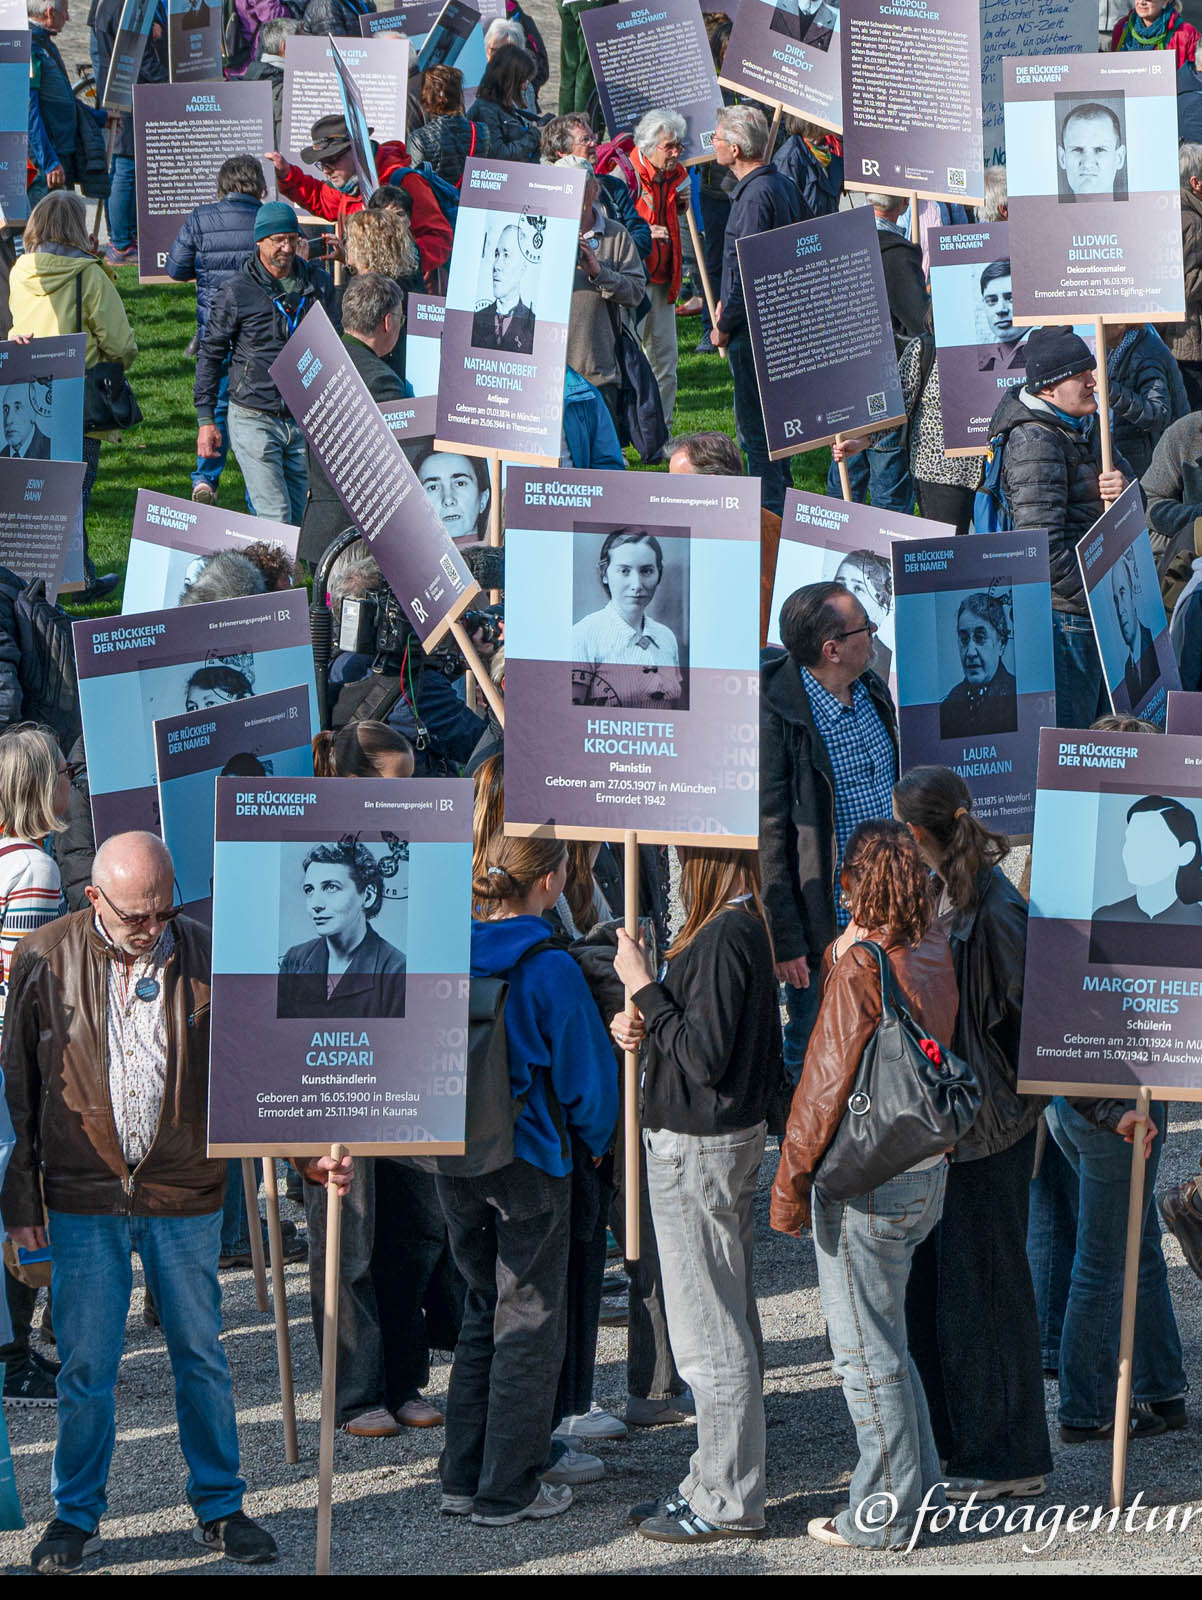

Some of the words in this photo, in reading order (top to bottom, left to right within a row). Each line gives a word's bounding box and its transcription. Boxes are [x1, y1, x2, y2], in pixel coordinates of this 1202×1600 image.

[879, 5, 939, 20] SCHWABACHER
[785, 43, 806, 59] DIRK
[772, 49, 814, 72] KOEDOOT
[1015, 66, 1028, 75] DIE
[1029, 64, 1069, 75] RÜCKKEHR
[1016, 74, 1031, 83] DER
[1031, 73, 1061, 83] NAMEN
[190, 95, 215, 103] ADELE
[185, 103, 221, 112] MARZELL
[796, 233, 820, 247] JOSEF
[1072, 233, 1117, 246] LUDWIG
[795, 242, 821, 257] STANG
[1068, 247, 1123, 260] BILLINGER
[1066, 263, 1126, 273] Dekorationsmaler
[1060, 278, 1089, 286] Geboren
[1102, 276, 1134, 285] 16.03.1913
[1034, 288, 1065, 298] Ermordet
[1079, 287, 1111, 296] 24.12.1942
[1112, 287, 1119, 295] in
[1120, 286, 1161, 297] Eglfing-Haar
[463, 356, 497, 372] NATHAN
[498, 361, 538, 378] NORBERT
[475, 373, 522, 391] ROSENTHAL
[525, 482, 542, 493] DIE
[544, 482, 603, 496] RÜCKKEHR
[524, 493, 546, 505] DER
[548, 494, 591, 507] NAMEN
[93, 630, 110, 644] DIE
[112, 623, 166, 642] RÜCKKEHR
[93, 640, 114, 655] DER
[116, 636, 156, 652] NAMEN
[587, 719, 674, 737] HENRIETTE
[584, 738, 678, 756] KROCHMAL
[963, 745, 997, 761] LAURA
[1058, 743, 1077, 754] DIE
[1079, 743, 1138, 758] RÜCKKEHR
[609, 761, 651, 773] Pianistin
[1058, 754, 1080, 766] DER
[1082, 756, 1125, 768] NAMEN
[545, 775, 587, 787] Geboren
[589, 780, 605, 788] am
[607, 779, 656, 791] 27.05.1907
[658, 781, 667, 791] in
[669, 782, 716, 794] München
[236, 792, 254, 803] DIE
[256, 790, 316, 804] RÜCKKEHR
[595, 792, 641, 804] Ermordet
[643, 794, 665, 805] 1942
[236, 805, 258, 815] DER
[260, 805, 304, 815] NAMEN
[375, 801, 432, 810] Erinnerungsprojekt
[439, 799, 453, 811] BR
[1082, 976, 1157, 994] MARGOT
[1122, 997, 1178, 1013] PORIES
[1126, 1019, 1171, 1031] Schülerin
[310, 1031, 369, 1046] ANIELA
[1063, 1033, 1105, 1045] Geboren
[1107, 1037, 1123, 1045] am
[1126, 1036, 1172, 1048] 21.01.1924
[1174, 1038, 1183, 1048] in
[305, 1050, 373, 1066] CASPARI
[1036, 1045, 1081, 1058] Ermordet
[1083, 1050, 1099, 1058] am
[1102, 1049, 1148, 1061] 15.07.1942
[1151, 1051, 1160, 1062] in
[301, 1073, 376, 1084] Kunsthändlerin
[256, 1092, 298, 1102] Geboren
[301, 1094, 317, 1102] am
[319, 1091, 370, 1102] 16.05.1900
[373, 1091, 382, 1101] in
[385, 1090, 420, 1101] Breslau
[258, 1106, 304, 1117] Ermordet
[306, 1108, 322, 1117] am
[325, 1106, 367, 1116] 25.11.1941
[370, 1105, 379, 1116] in
[382, 1106, 417, 1116] Kaunas
